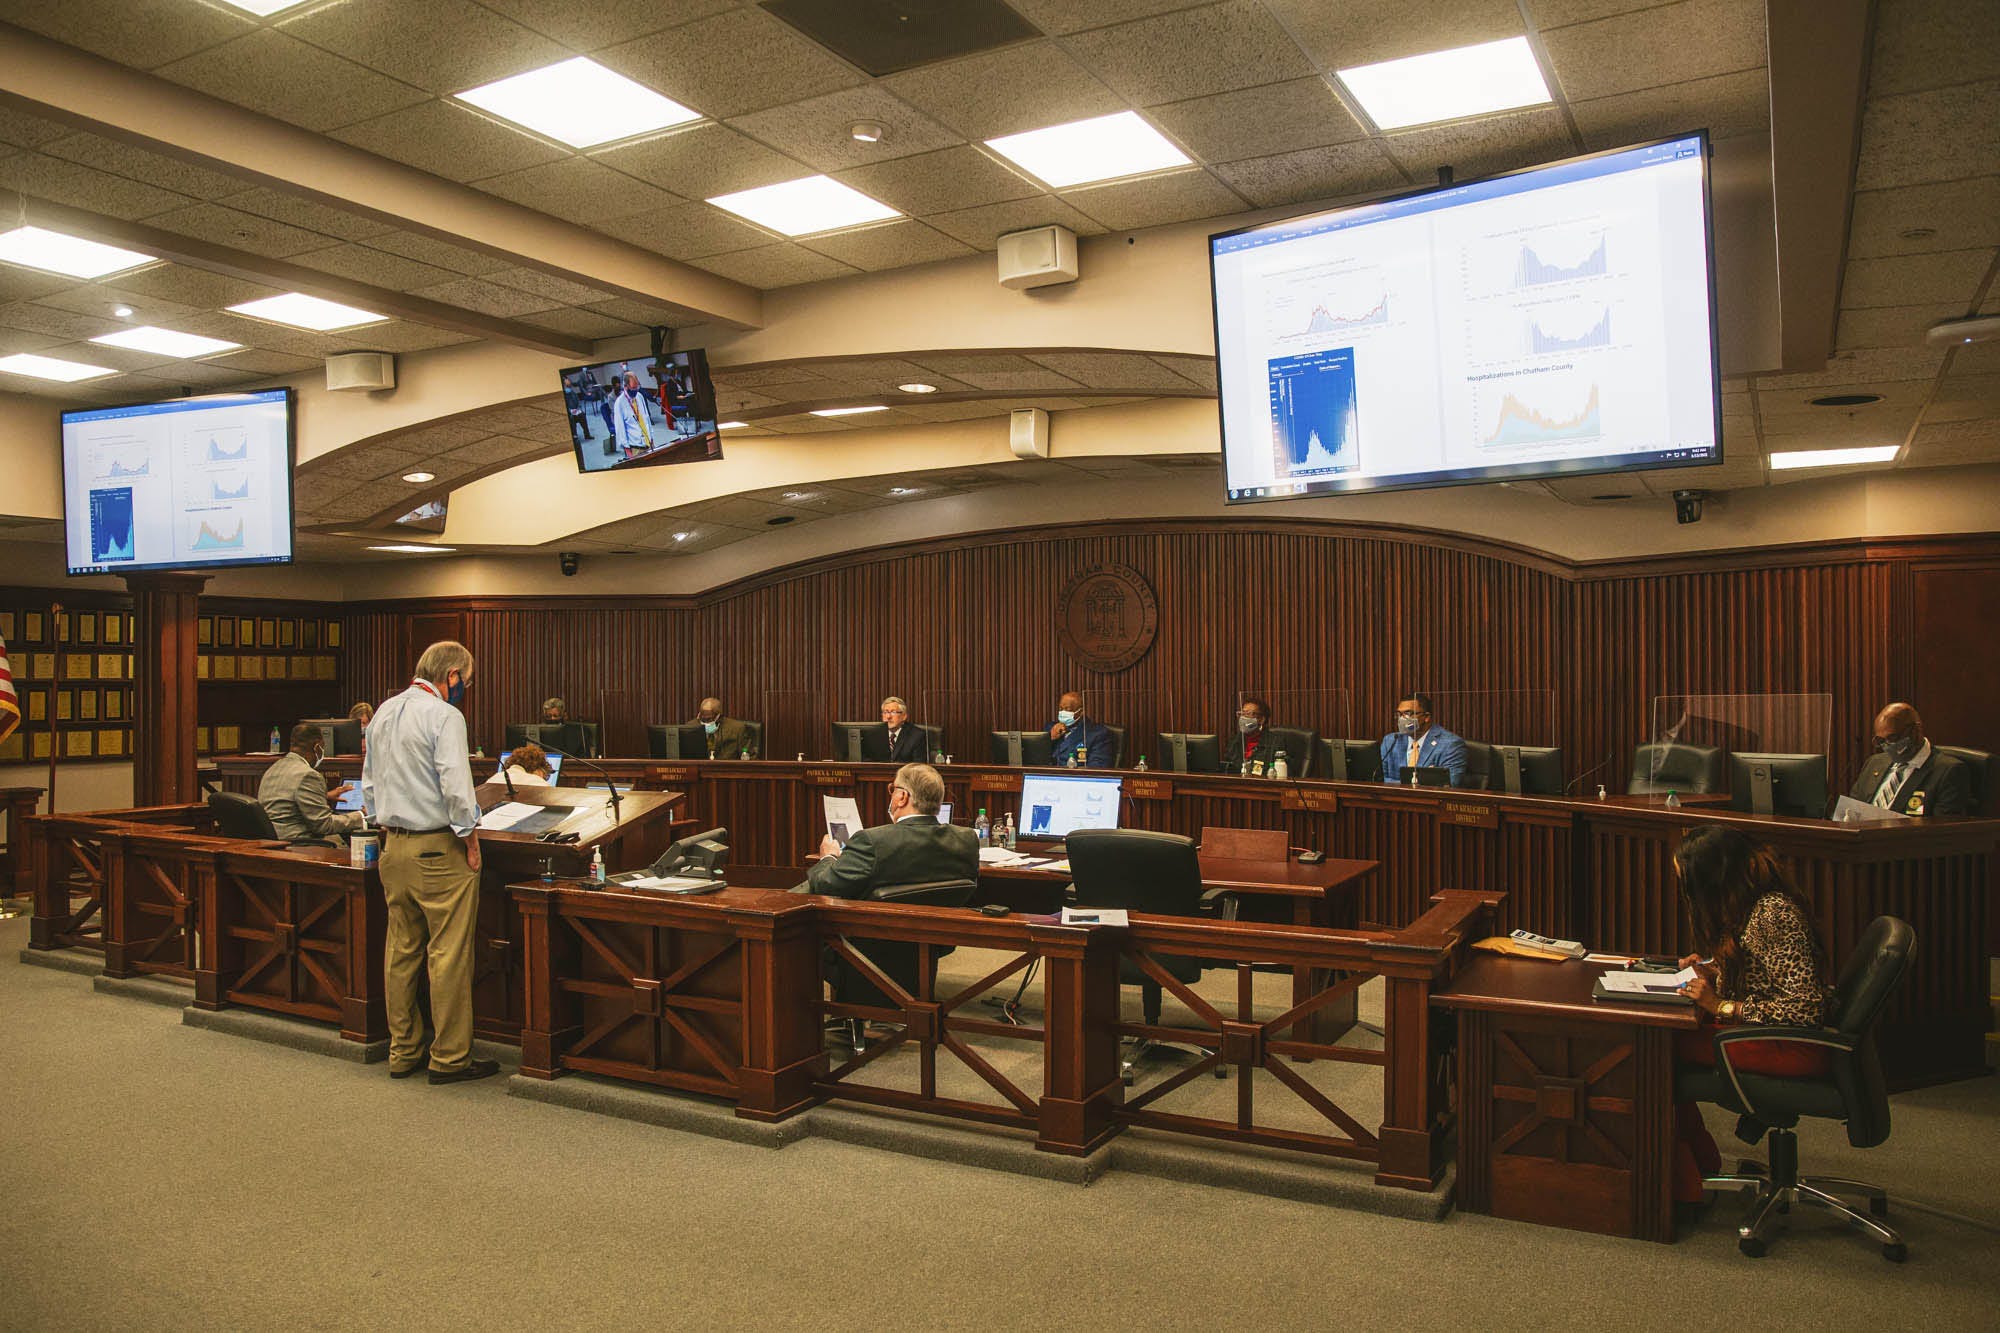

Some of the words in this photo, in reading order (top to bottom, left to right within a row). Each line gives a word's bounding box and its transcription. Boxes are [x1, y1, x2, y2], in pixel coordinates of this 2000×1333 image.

[1467, 369, 1515, 382] Hospitalizations
[1522, 366, 1550, 375] Chatham
[1551, 363, 1573, 372] County
